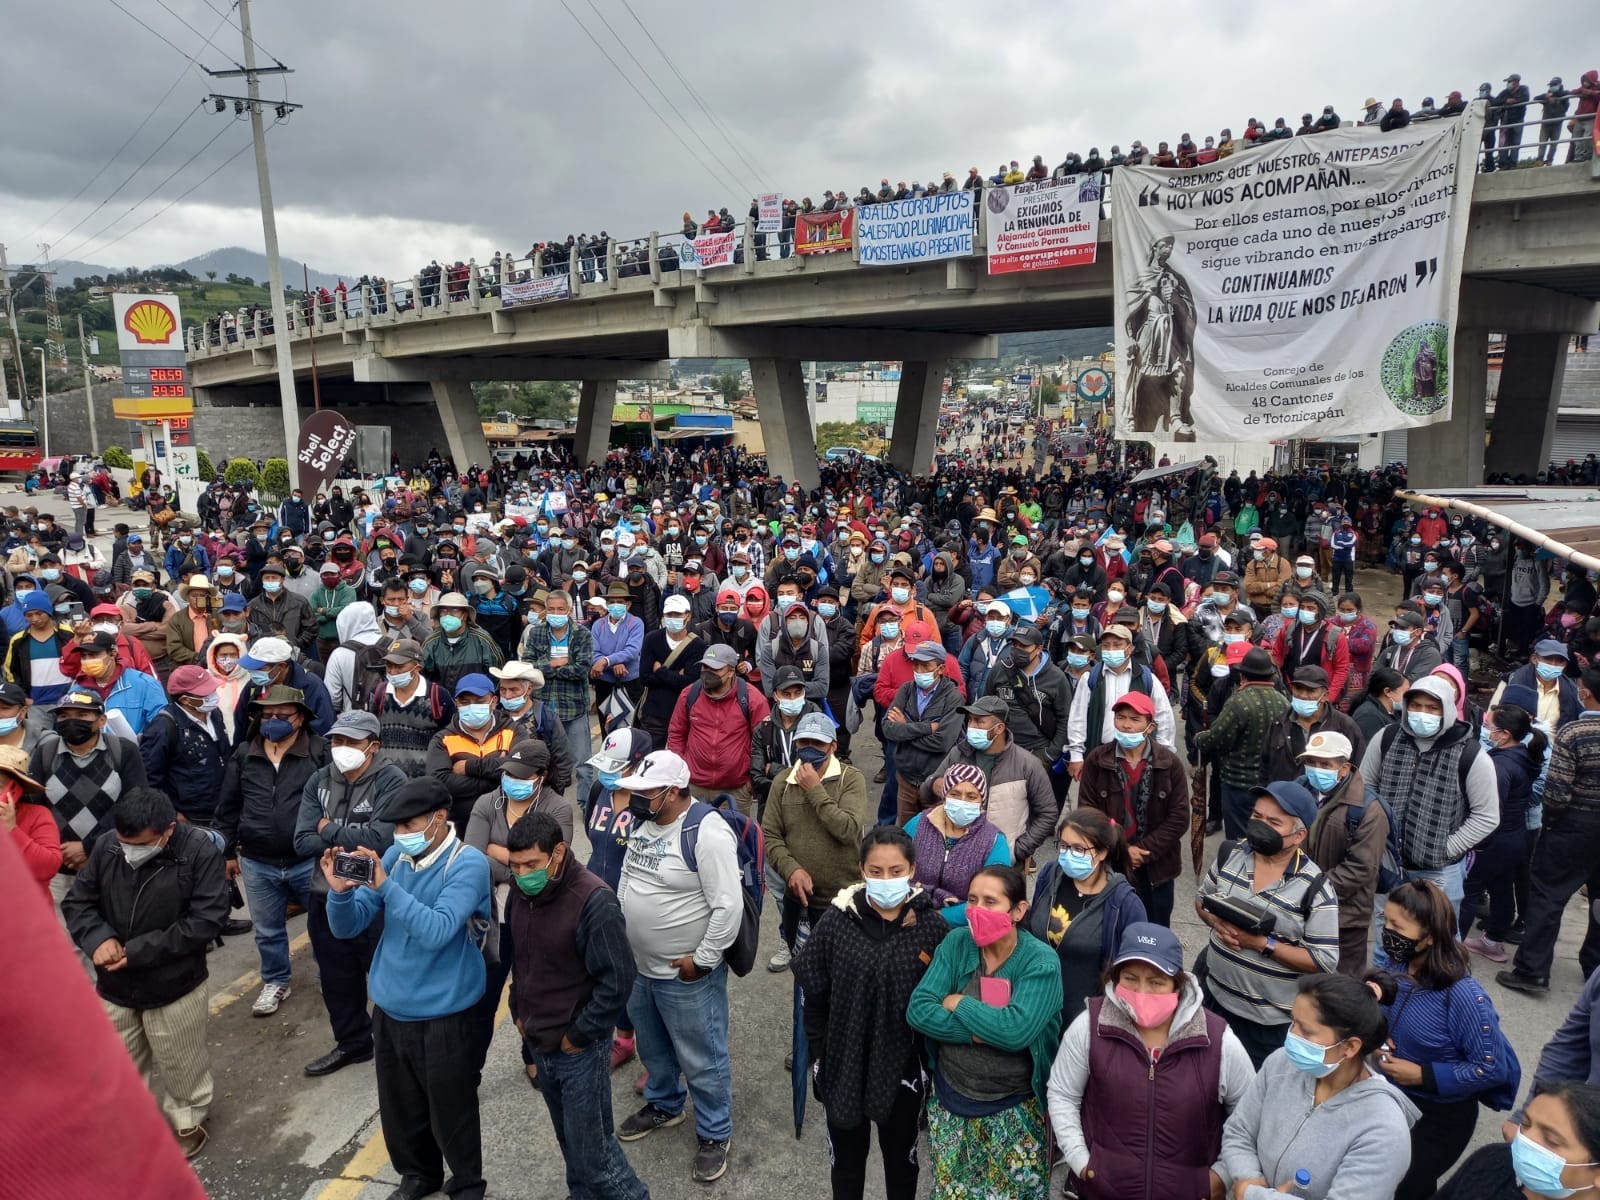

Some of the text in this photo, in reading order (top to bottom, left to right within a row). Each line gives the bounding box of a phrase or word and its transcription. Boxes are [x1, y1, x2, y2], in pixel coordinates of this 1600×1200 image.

[1168, 170, 1225, 189] SABEMOS
[1227, 163, 1253, 180] QUE
[1257, 151, 1321, 176] NUESTROS
[858, 191, 971, 221] NO A LOS CORRUPTOS
[1016, 200, 1064, 218] EXIGIMOS
[1023, 190, 1059, 205] PRESENTE
[1166, 192, 1199, 211] HOY
[1202, 186, 1235, 207] NOS
[1004, 210, 1082, 232] LA RENUNCIA DE
[1195, 218, 1219, 231] Por
[1222, 211, 1259, 228] ellos
[1365, 190, 1406, 208] ellos
[997, 221, 1091, 243] Alejandro Giammattei
[1187, 236, 1240, 254] porque
[1243, 228, 1278, 244] cada
[1282, 225, 1312, 240] uno
[1317, 221, 1336, 236] de
[928, 233, 972, 257] PRESENTE
[997, 236, 1069, 252] Y Consuelo Porras
[1019, 247, 1077, 261] corrupción
[1022, 261, 1031, 269] de
[1201, 255, 1241, 271] sigue
[1244, 245, 1315, 265] vibrando
[1319, 244, 1340, 257] en
[1221, 266, 1335, 295] CONTINUAMOS
[1207, 273, 1408, 324] LA VIDA QUE NOS DEJARON
[1225, 369, 1365, 392] Alcaldes Comunales de los
[1263, 362, 1324, 377] Concejo de
[1252, 391, 1335, 408] 48 Cantones
[1243, 407, 1345, 425] de Totonicapán
[298, 432, 322, 464] Shell
[311, 424, 348, 472] Select
